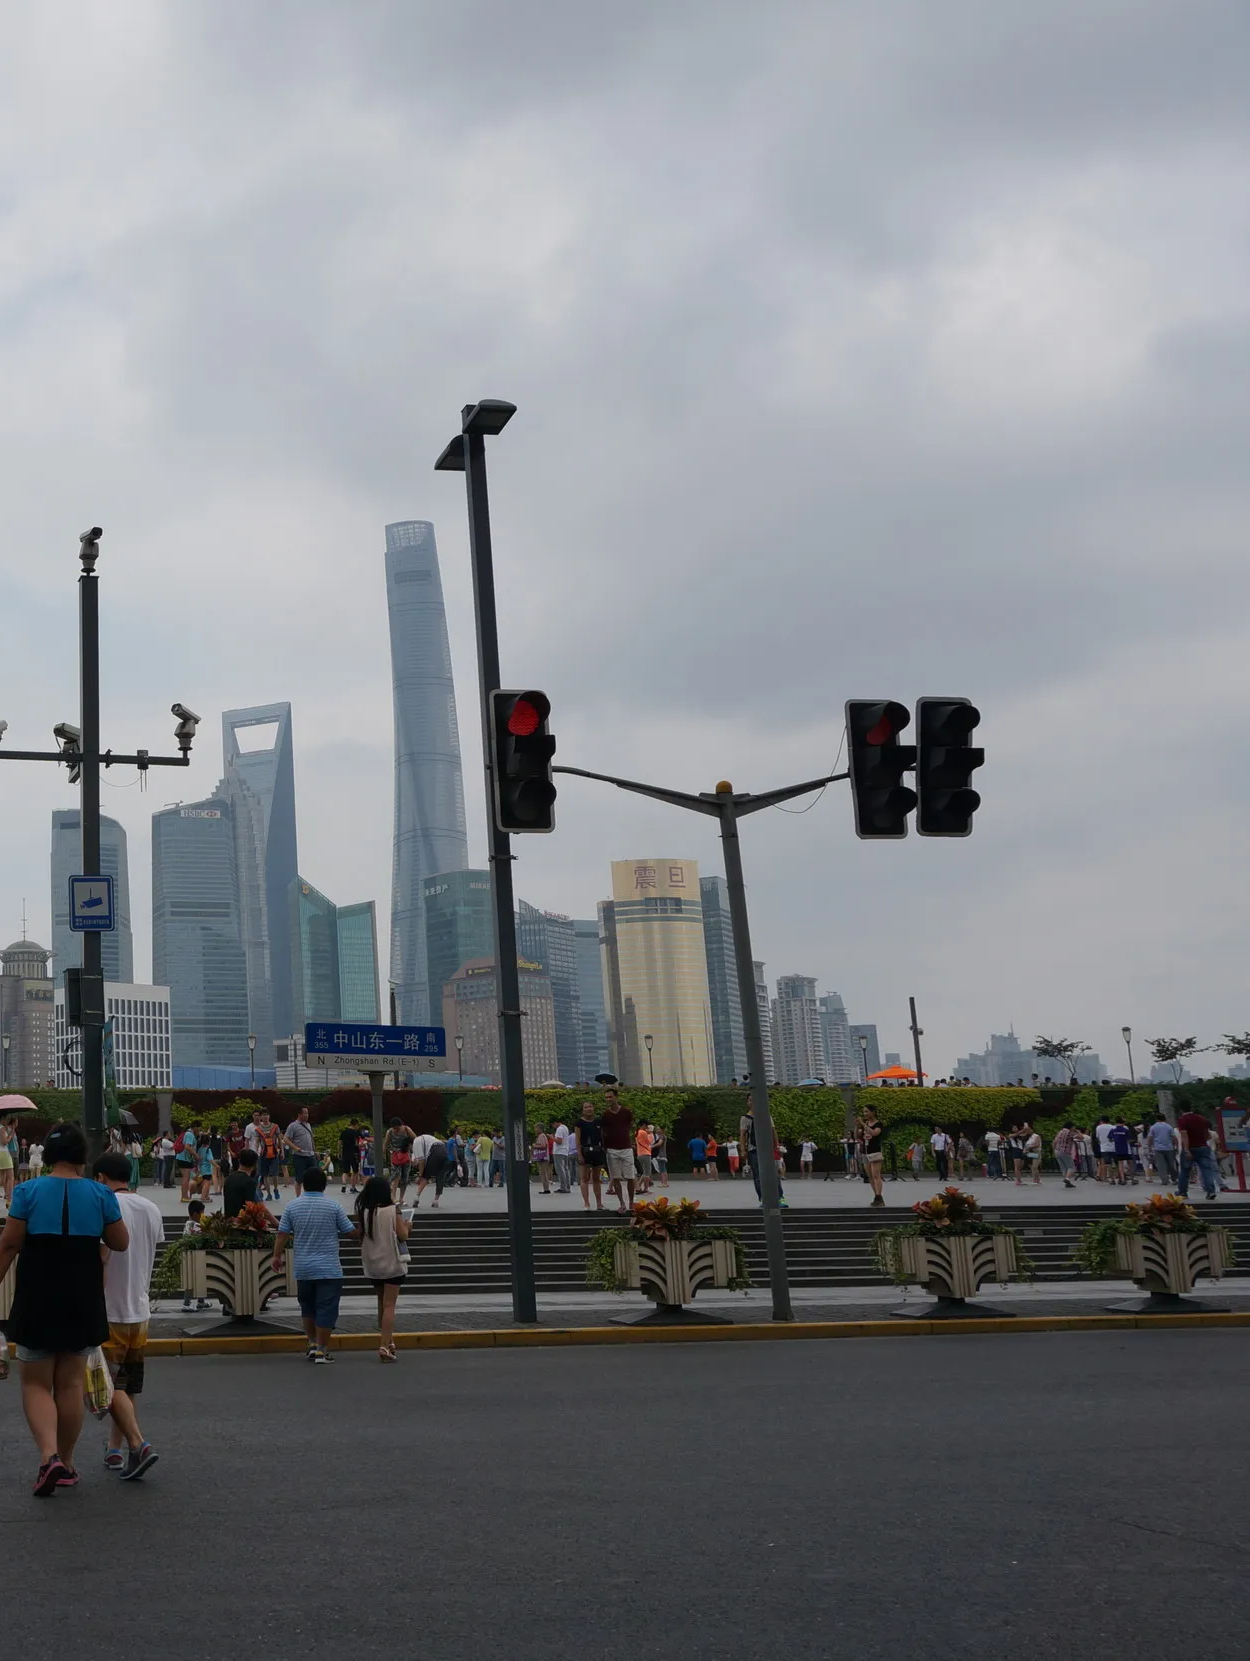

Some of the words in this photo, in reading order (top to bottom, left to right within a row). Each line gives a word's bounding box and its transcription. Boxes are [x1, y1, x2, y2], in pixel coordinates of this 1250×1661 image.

[634, 866, 686, 889] 震旦
[316, 1028, 327, 1039] 北
[426, 1032, 436, 1044] 南
[314, 1041, 329, 1049] 355
[334, 1030, 420, 1051] 中山东一路
[317, 1056, 326, 1065] N
[334, 1056, 379, 1066] Zhongshan
[427, 1059, 436, 1068] S
